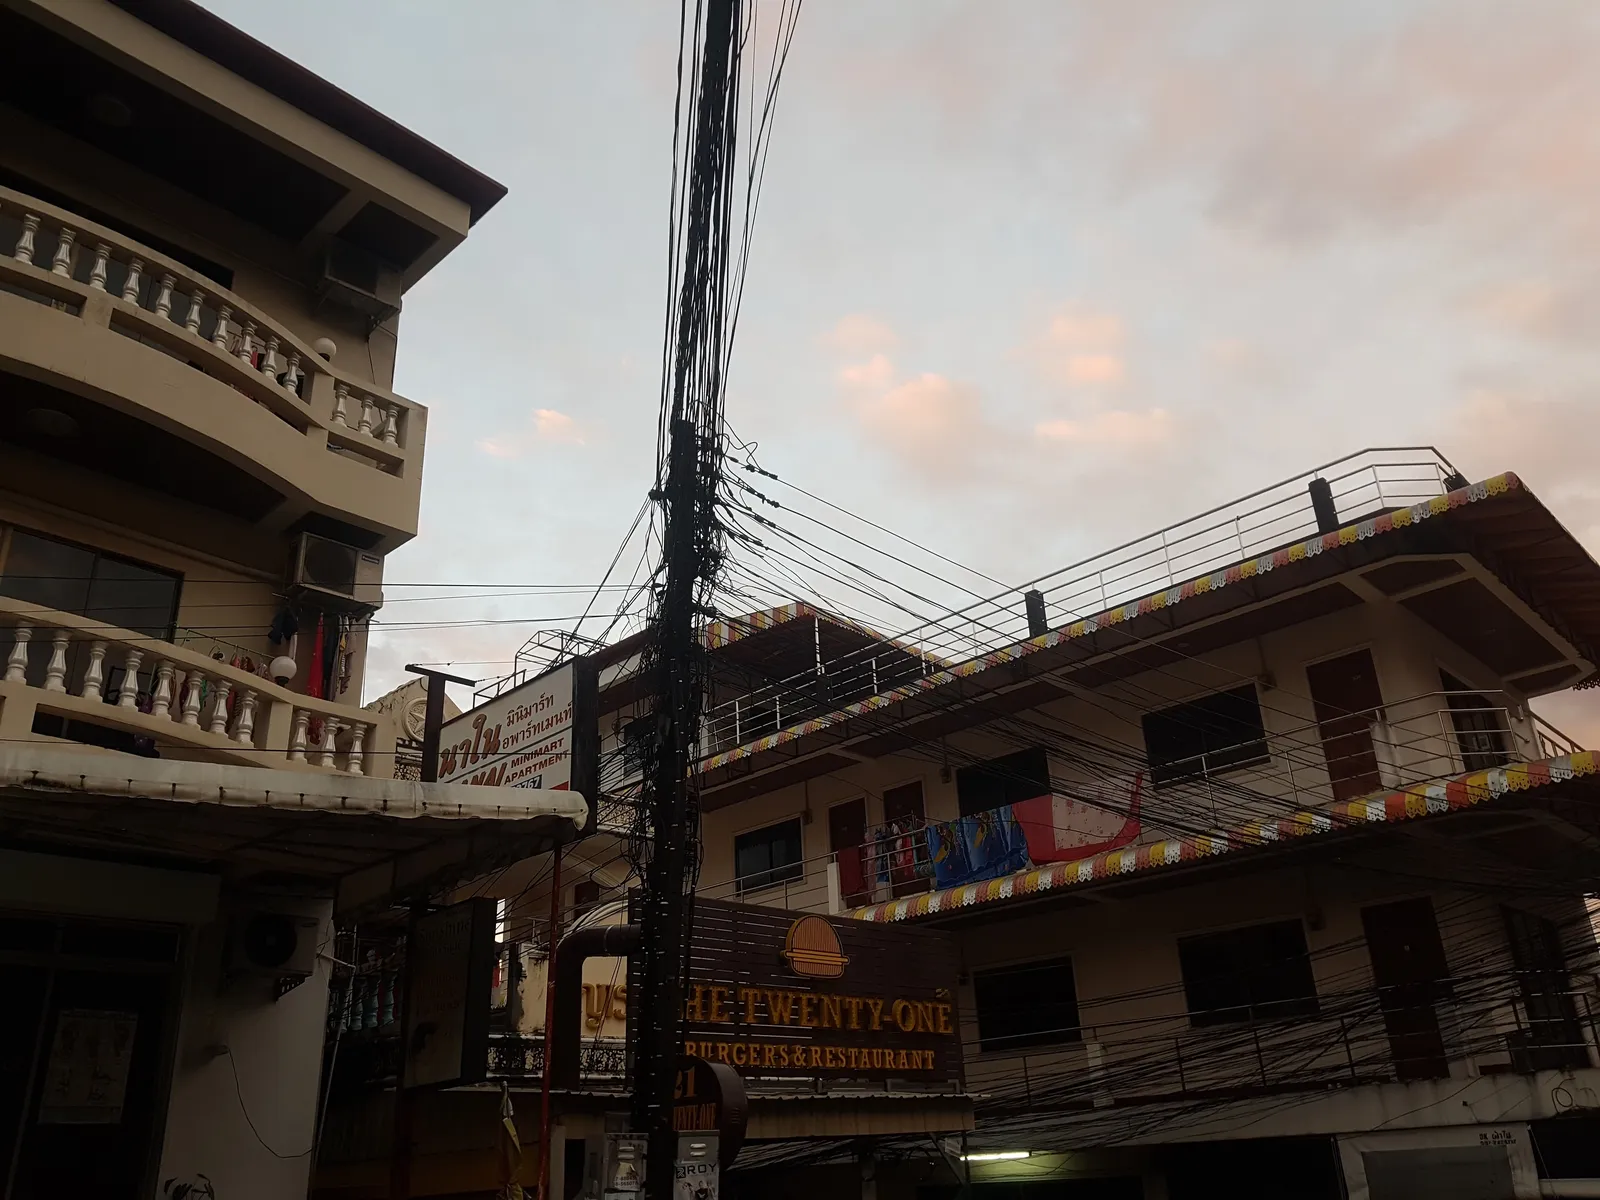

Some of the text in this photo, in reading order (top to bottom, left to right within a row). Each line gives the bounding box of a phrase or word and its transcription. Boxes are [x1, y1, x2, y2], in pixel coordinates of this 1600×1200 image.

[502, 701, 573, 750] อพาร์ทเมนท์
[506, 692, 554, 727] มินิมาร์ท
[504, 750, 570, 785] APARTMENT
[511, 737, 565, 769] MINIMART
[684, 984, 954, 1035] HE TWENTY-ONE
[684, 1039, 936, 1071] BURGERS&RESTAURANT
